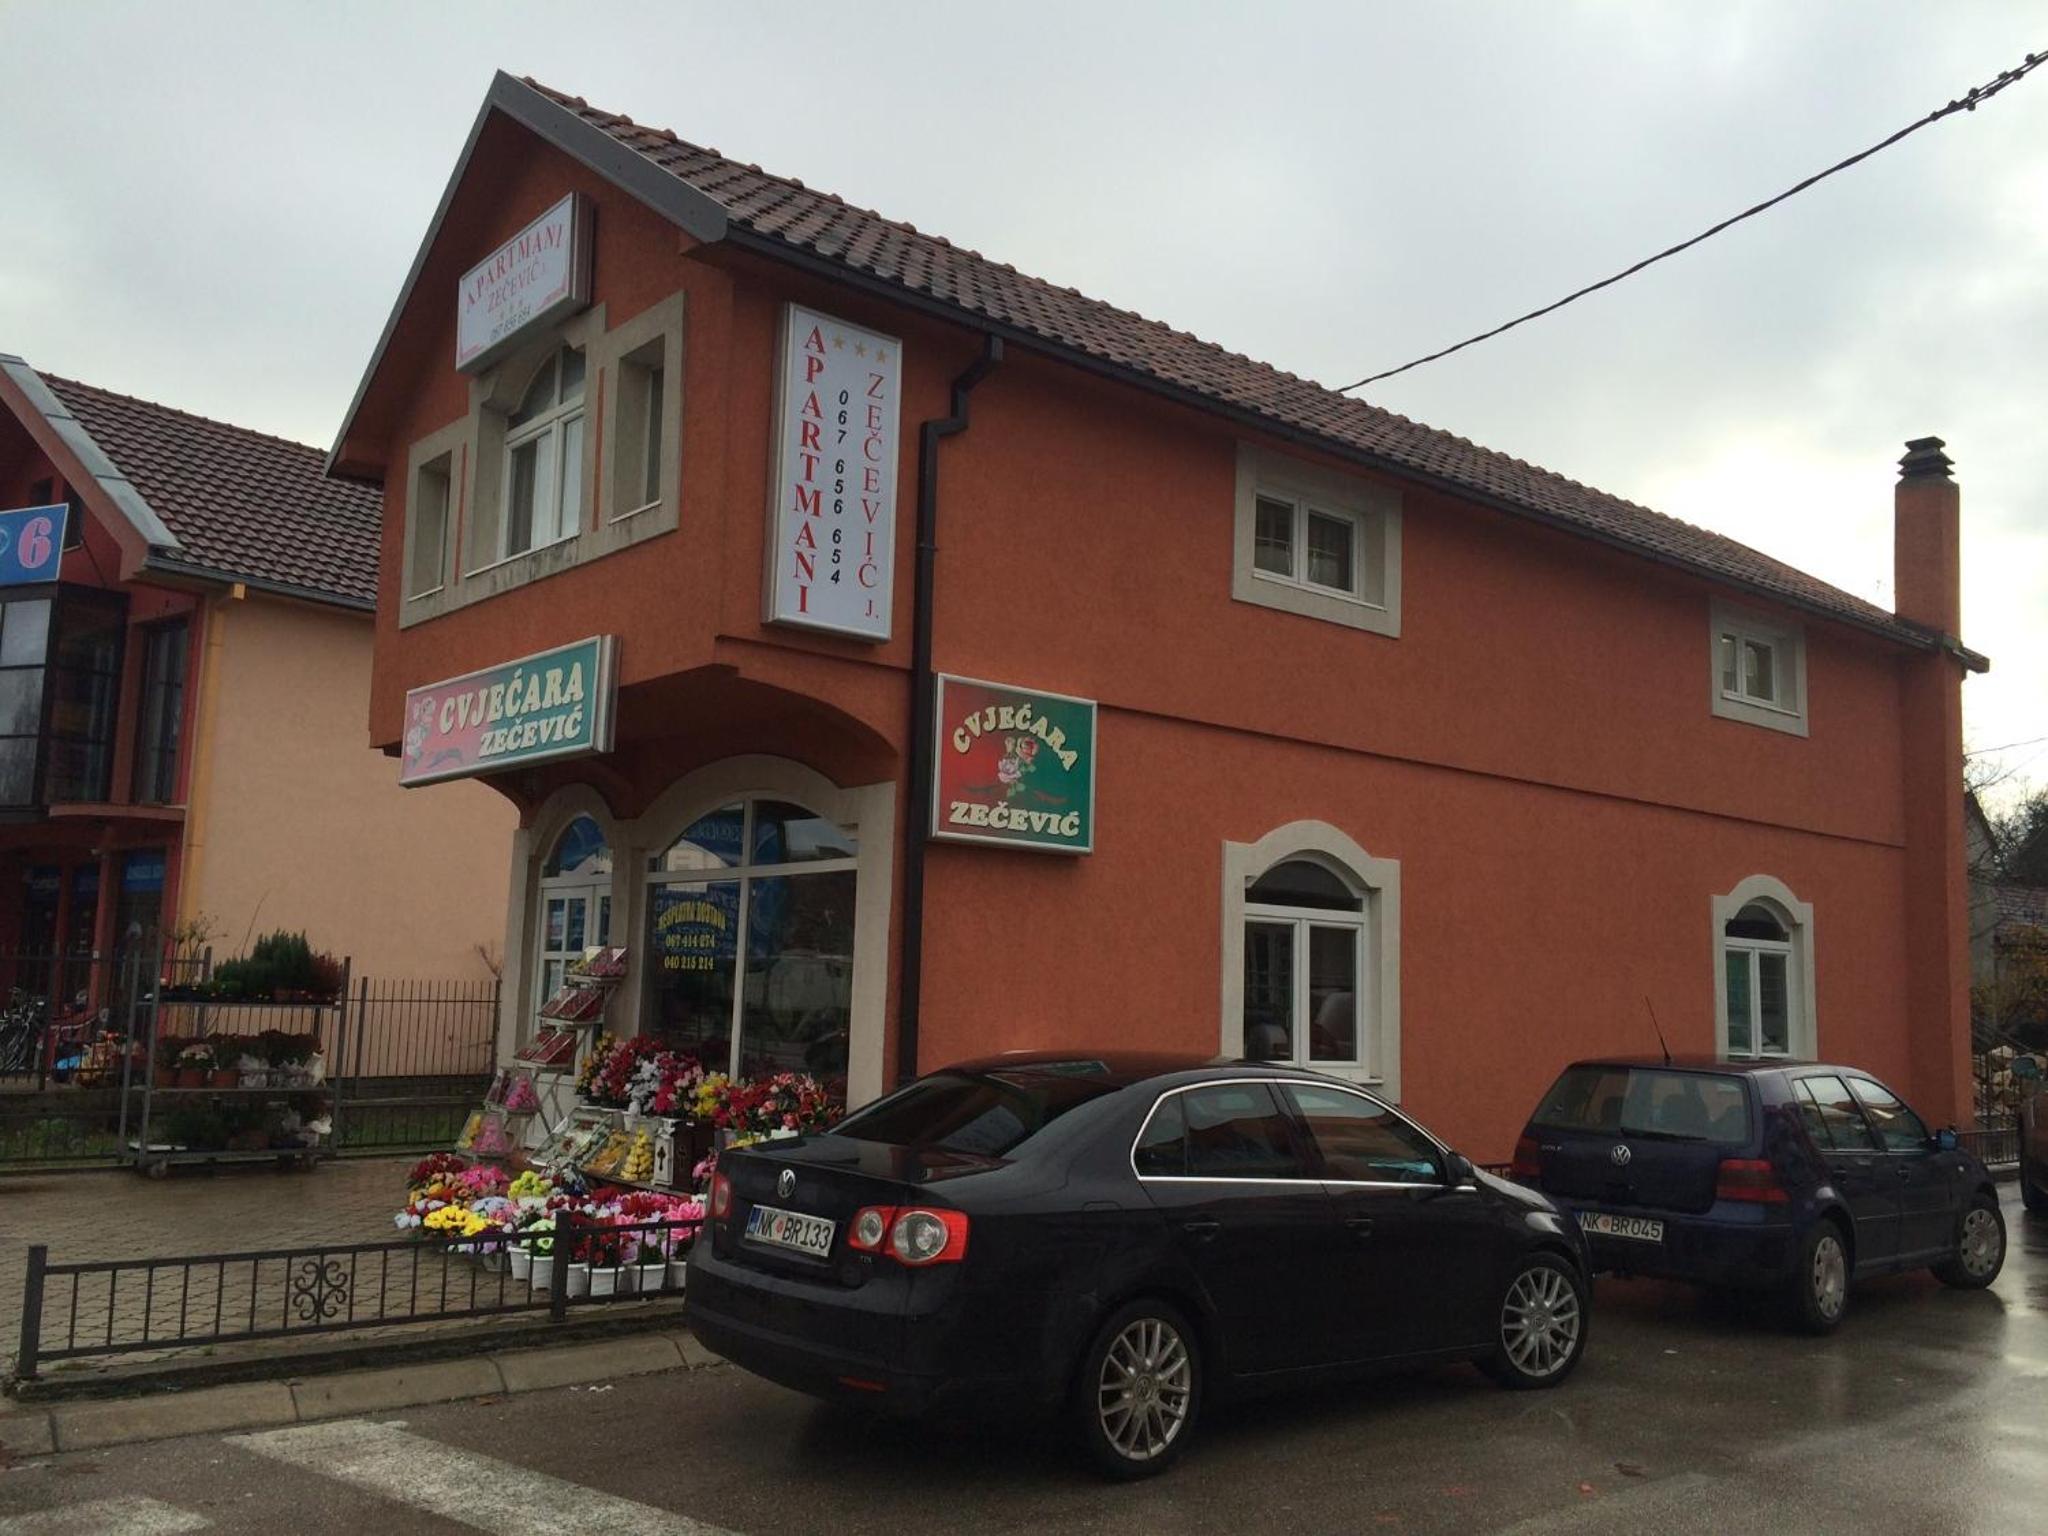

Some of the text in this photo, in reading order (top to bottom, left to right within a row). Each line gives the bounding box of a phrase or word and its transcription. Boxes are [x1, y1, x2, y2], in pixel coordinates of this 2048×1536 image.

[466, 223, 563, 314] APARTMANI
[792, 325, 826, 614] APARTMANI
[478, 705, 584, 758] ZEČEVIĆ
[949, 801, 1080, 837] ZEČEVIĆ
[757, 1211, 777, 1237] NK
[1582, 1211, 1601, 1230] NK
